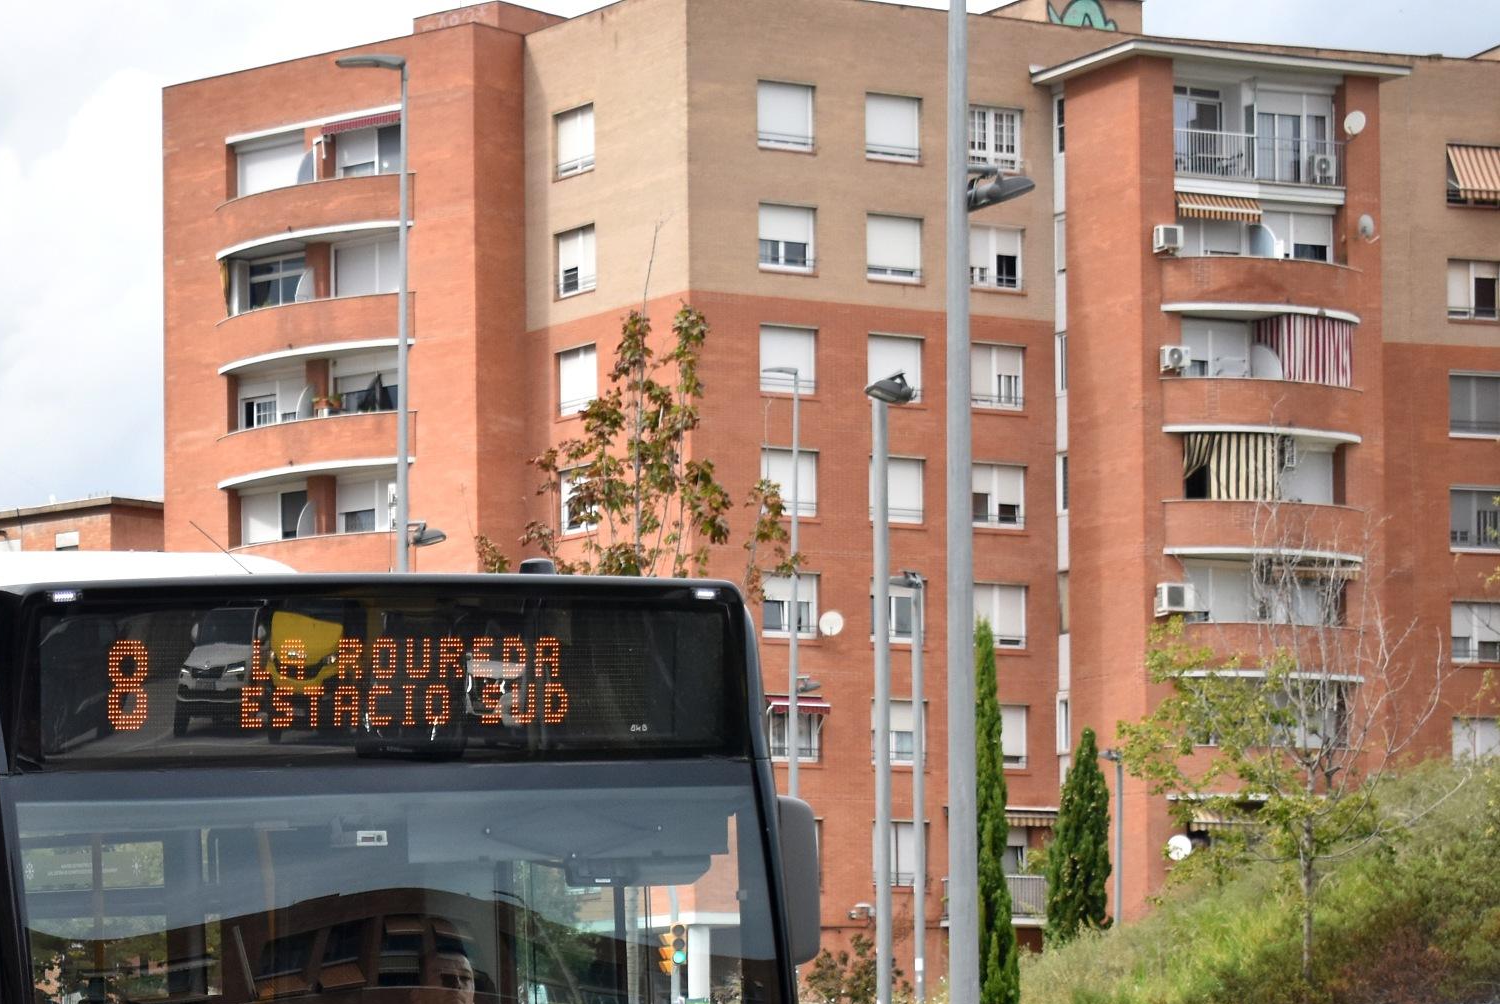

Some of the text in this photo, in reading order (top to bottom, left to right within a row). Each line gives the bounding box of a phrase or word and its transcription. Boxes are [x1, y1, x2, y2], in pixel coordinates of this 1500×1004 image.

[251, 635, 562, 681] LA ROUREDA
[107, 639, 149, 730] 8
[239, 682, 569, 729] ESTACIO SUD
